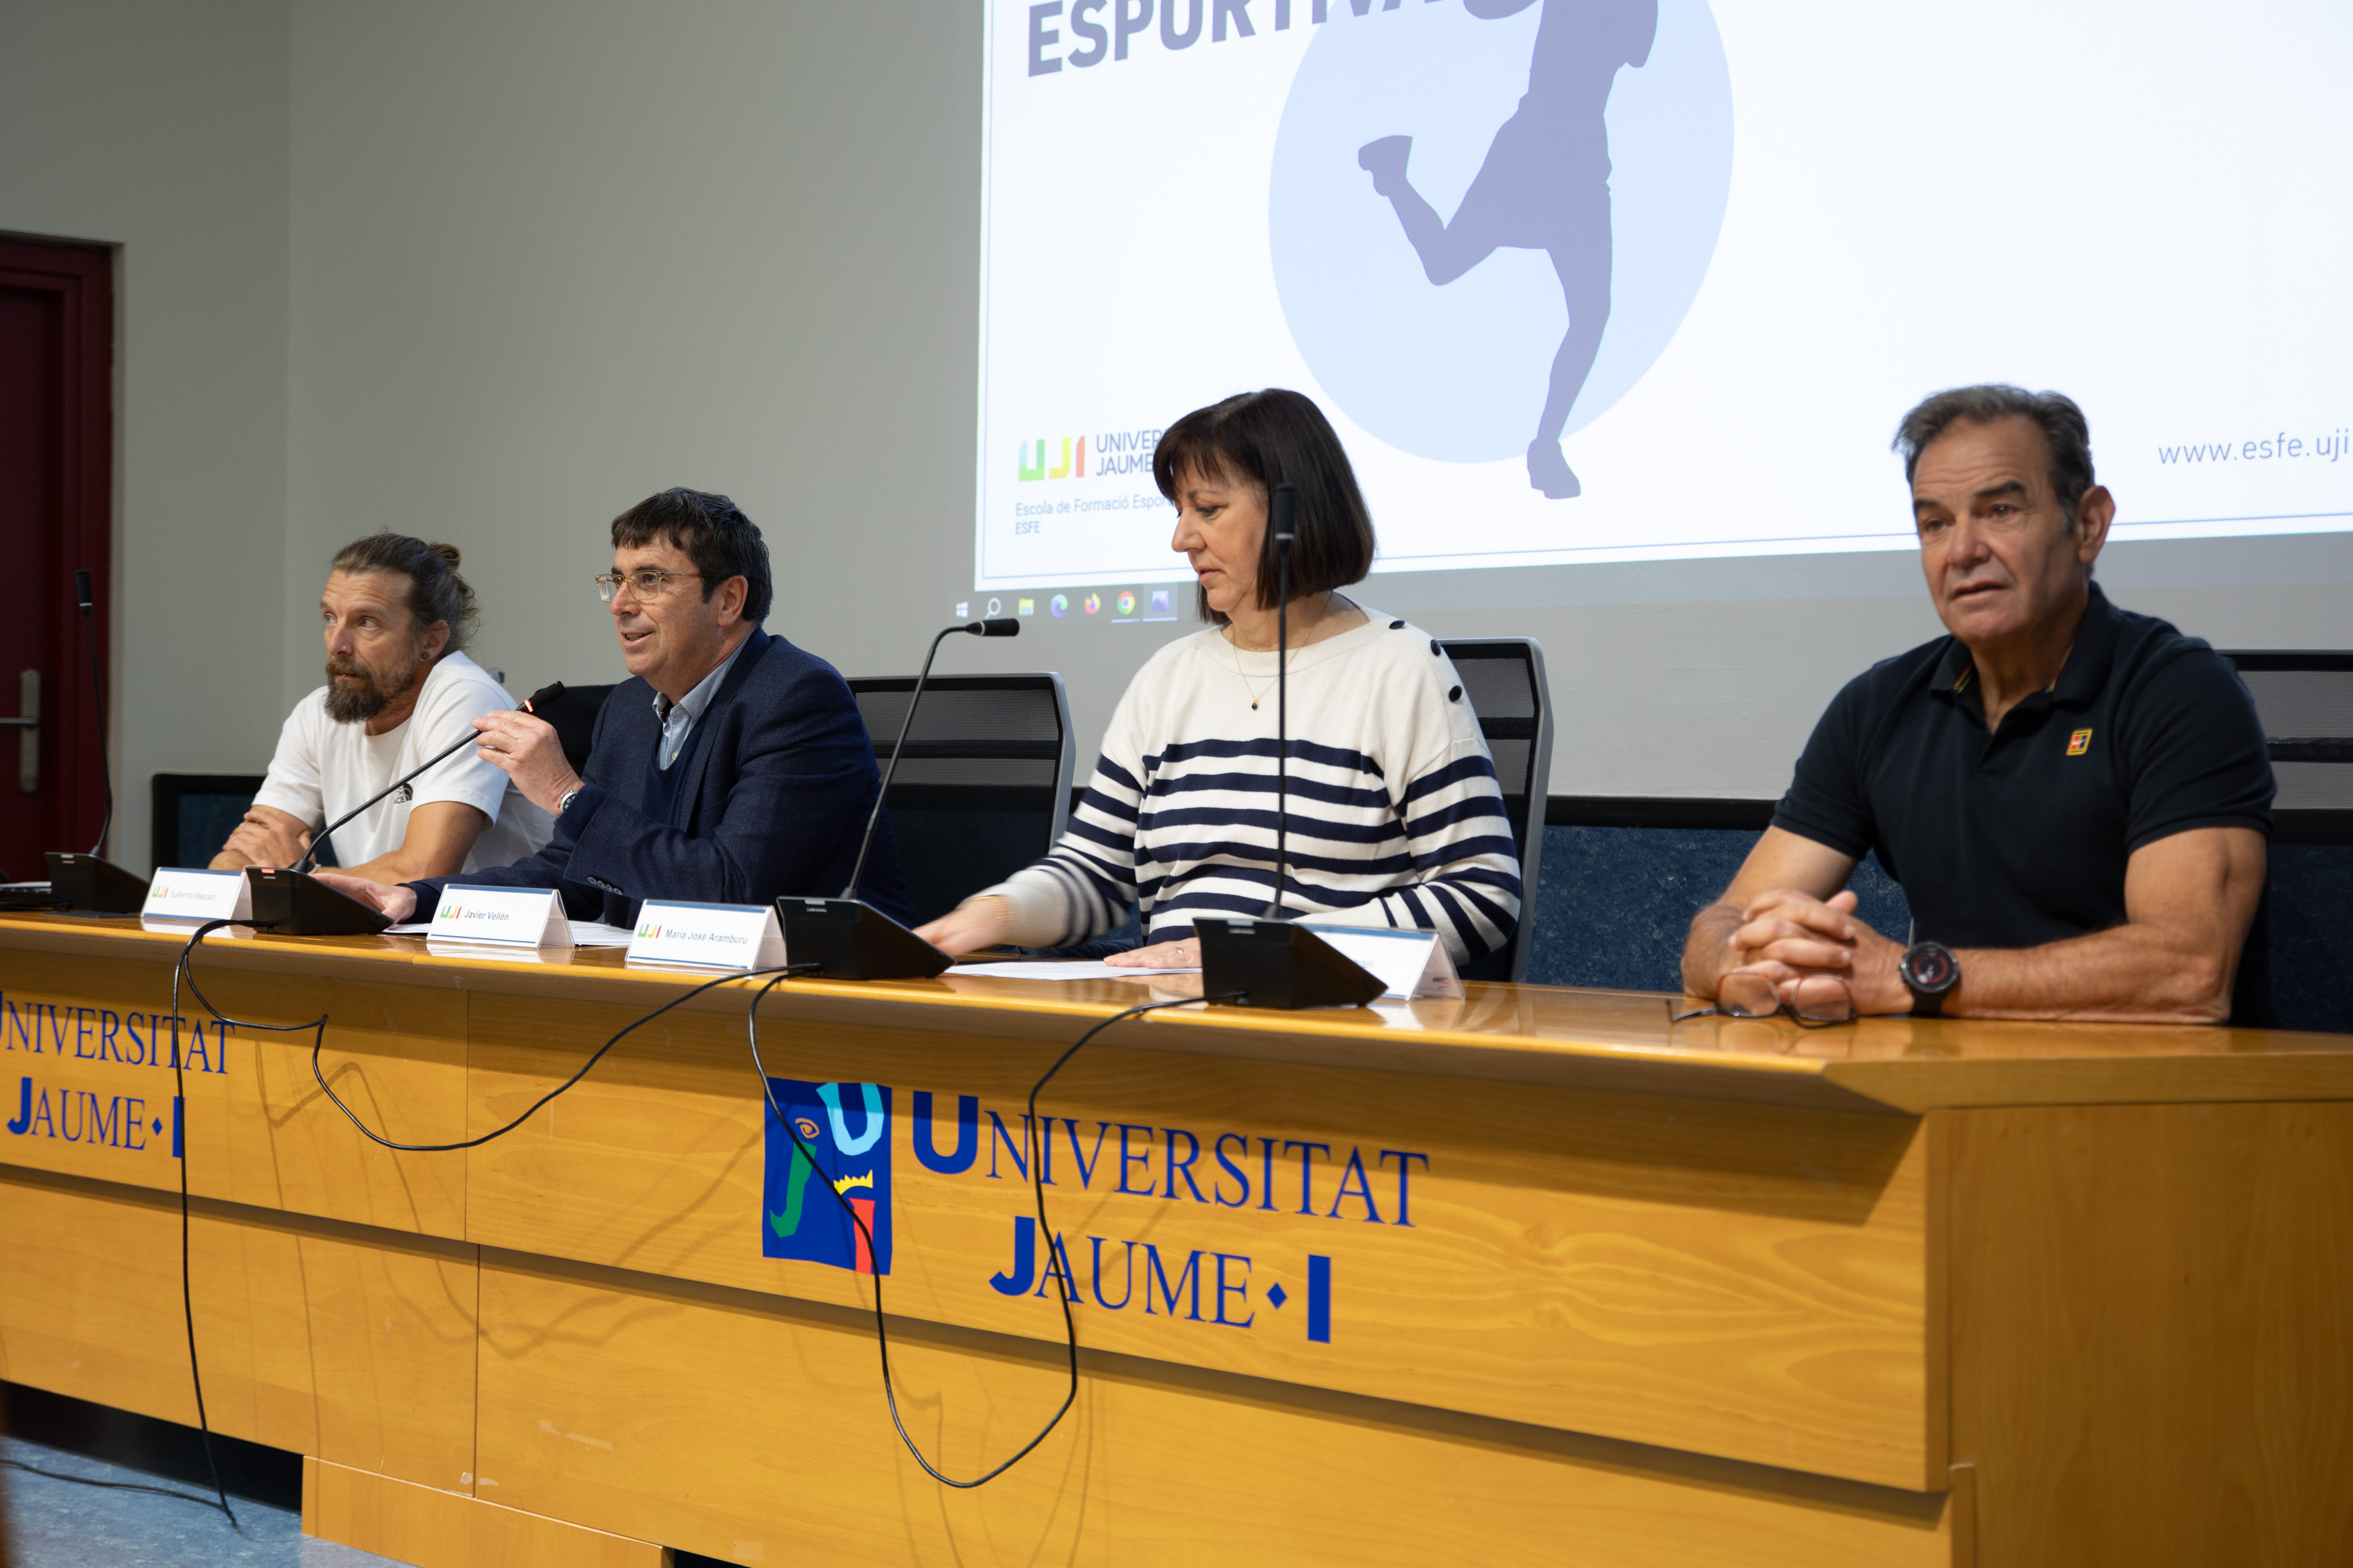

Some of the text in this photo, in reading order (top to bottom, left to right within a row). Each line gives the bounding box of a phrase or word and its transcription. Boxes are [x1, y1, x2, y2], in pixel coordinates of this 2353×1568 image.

[1028, 0, 1443, 77] ESPOR
[1096, 429, 1164, 453] UNIVER
[2159, 428, 2349, 464] www.esfe.uji
[1096, 453, 1153, 476] JAUME
[1015, 494, 1170, 516] Escola de Formació Espor
[1015, 521, 1040, 535] ESFE
[464, 910, 486, 919] Javier
[488, 911, 509, 921] Vellón
[688, 931, 706, 941] José
[708, 933, 748, 945] Aramburu
[0, 990, 235, 1075] NIVERSITAT
[7, 1077, 146, 1151] JAUME
[913, 1090, 1429, 1228] UNIVERSITAT
[988, 1216, 1255, 1329] JAUME
